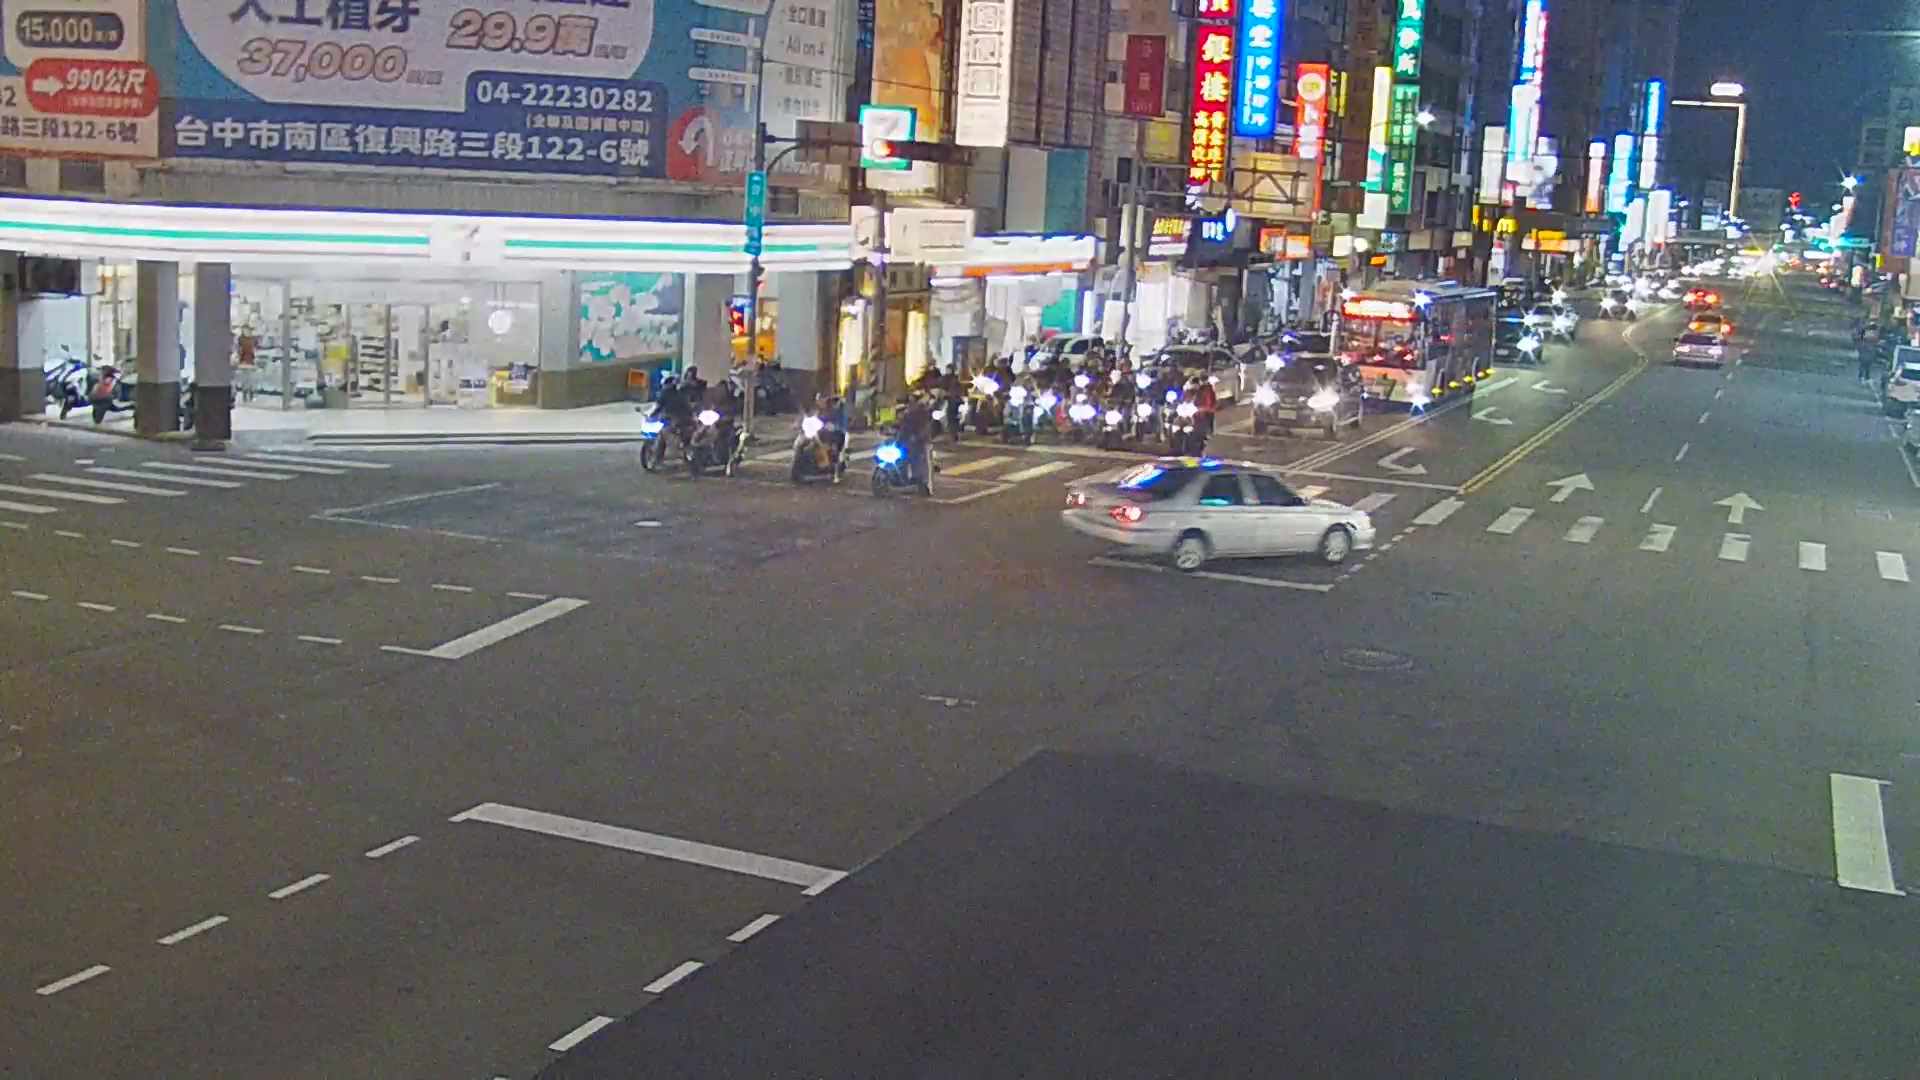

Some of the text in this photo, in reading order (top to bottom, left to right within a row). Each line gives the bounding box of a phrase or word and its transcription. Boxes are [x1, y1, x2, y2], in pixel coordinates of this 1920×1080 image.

[446, 8, 597, 57] 29.9萬
[239, 37, 409, 84] 37,000
[65, 67, 147, 96] 990公尺
[476, 80, 653, 112] 04-22230282
[0, 115, 139, 145] 路三段122-6號
[175, 115, 650, 166] 台中市南區復興路三段122-6號
